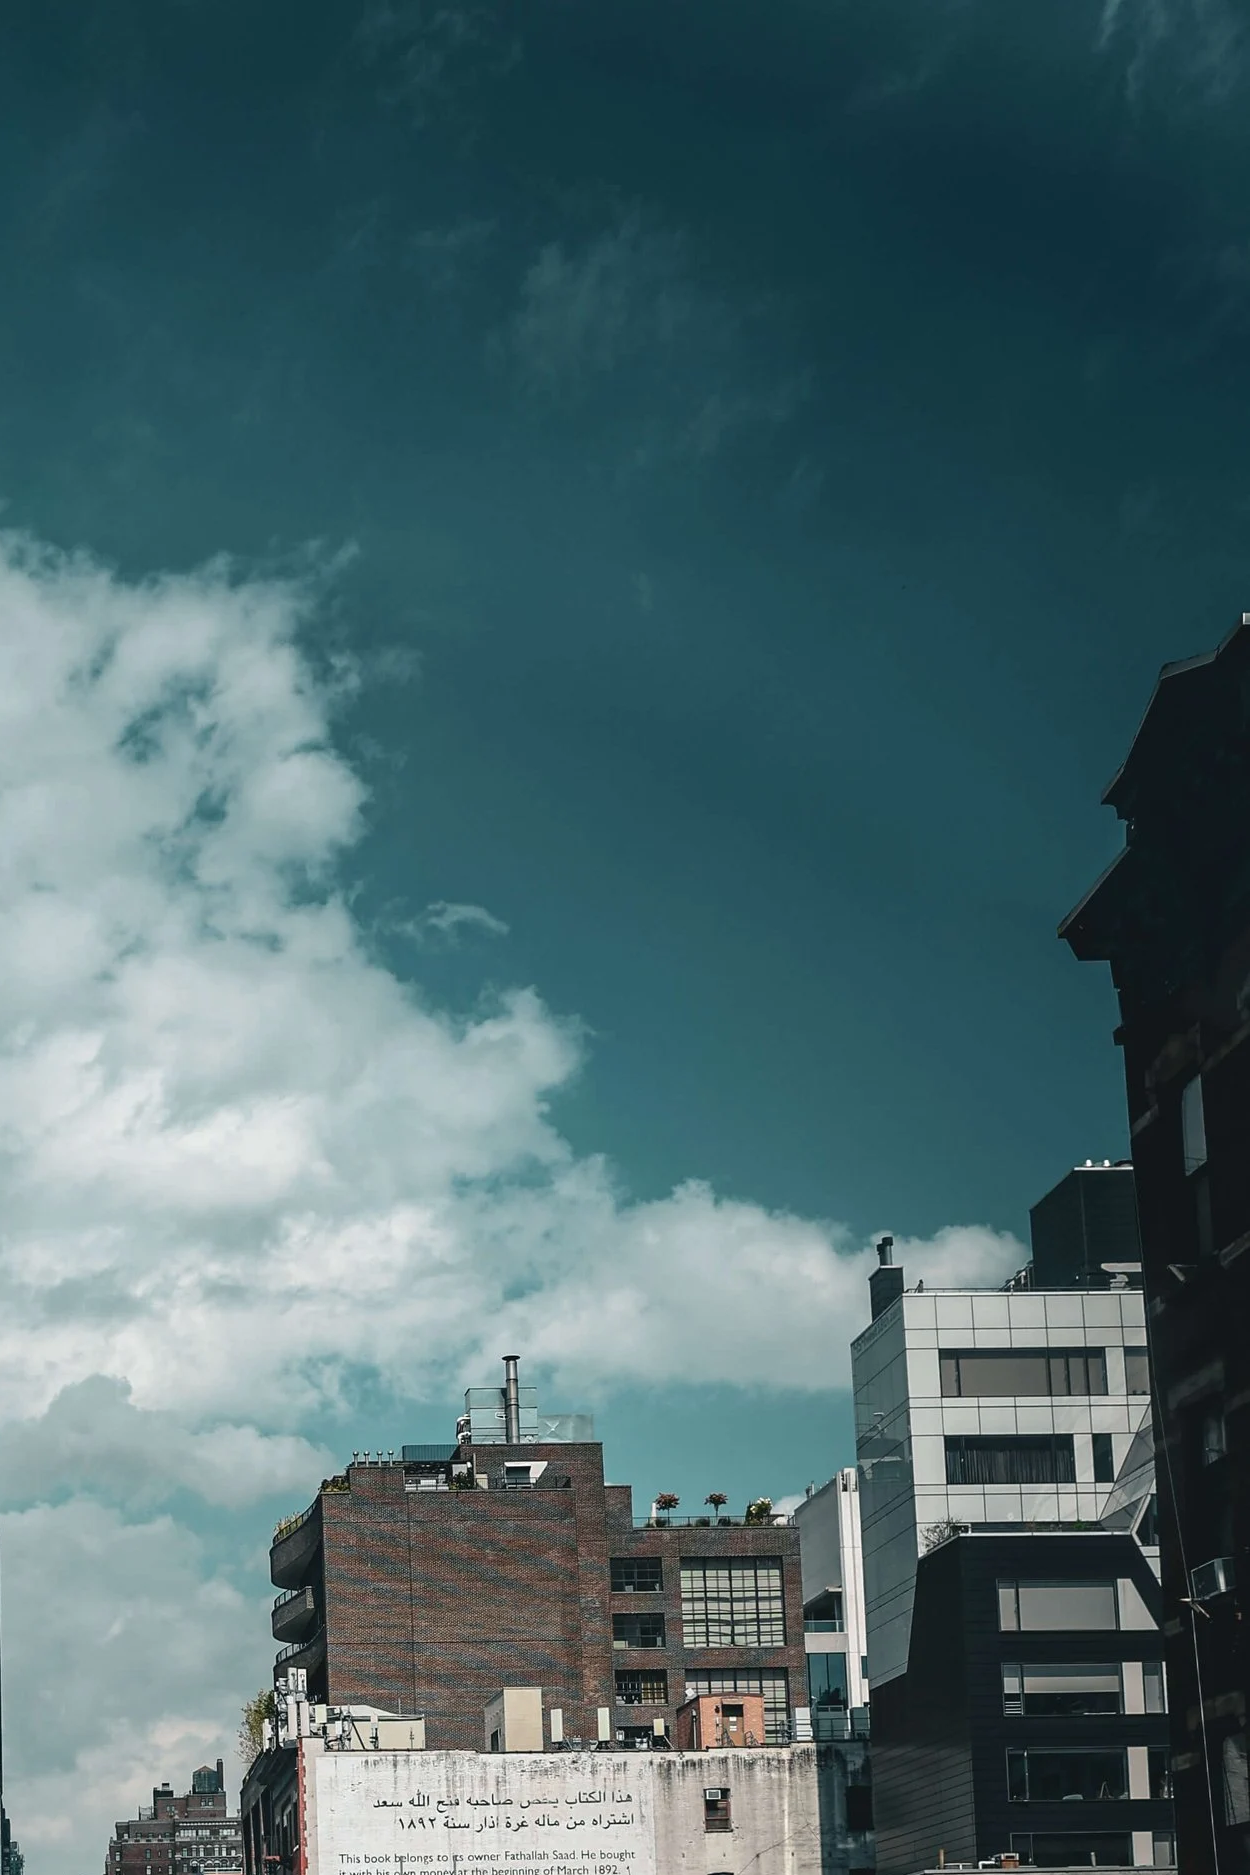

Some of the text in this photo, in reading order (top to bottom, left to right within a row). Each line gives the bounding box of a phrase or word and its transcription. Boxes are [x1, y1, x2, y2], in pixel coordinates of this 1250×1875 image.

[372, 1799, 403, 1808] سعد
[408, 1789, 430, 1807] الله
[466, 1793, 513, 1810] صاحبه
[564, 1790, 606, 1809] الكتاب
[611, 1789, 633, 1803] هذا
[436, 1796, 460, 1813] فتح
[398, 1817, 437, 1830] ١٨٩٢
[443, 1815, 470, 1829] سنة
[505, 1815, 529, 1832] غرة
[566, 1818, 586, 1830] من
[591, 1813, 634, 1830] اشتراه
[338, 1853, 361, 1864] This
[364, 1852, 391, 1863] book
[394, 1852, 434, 1865] belongs
[437, 1853, 449, 1862] to
[467, 1853, 501, 1862] owner
[504, 1850, 549, 1860] Fathallah
[552, 1849, 578, 1860] Saad.
[581, 1850, 597, 1860] He
[599, 1849, 636, 1863] bought
[543, 1865, 555, 1875] of
[557, 1865, 589, 1875] March
[594, 1864, 621, 1875] 1892.
